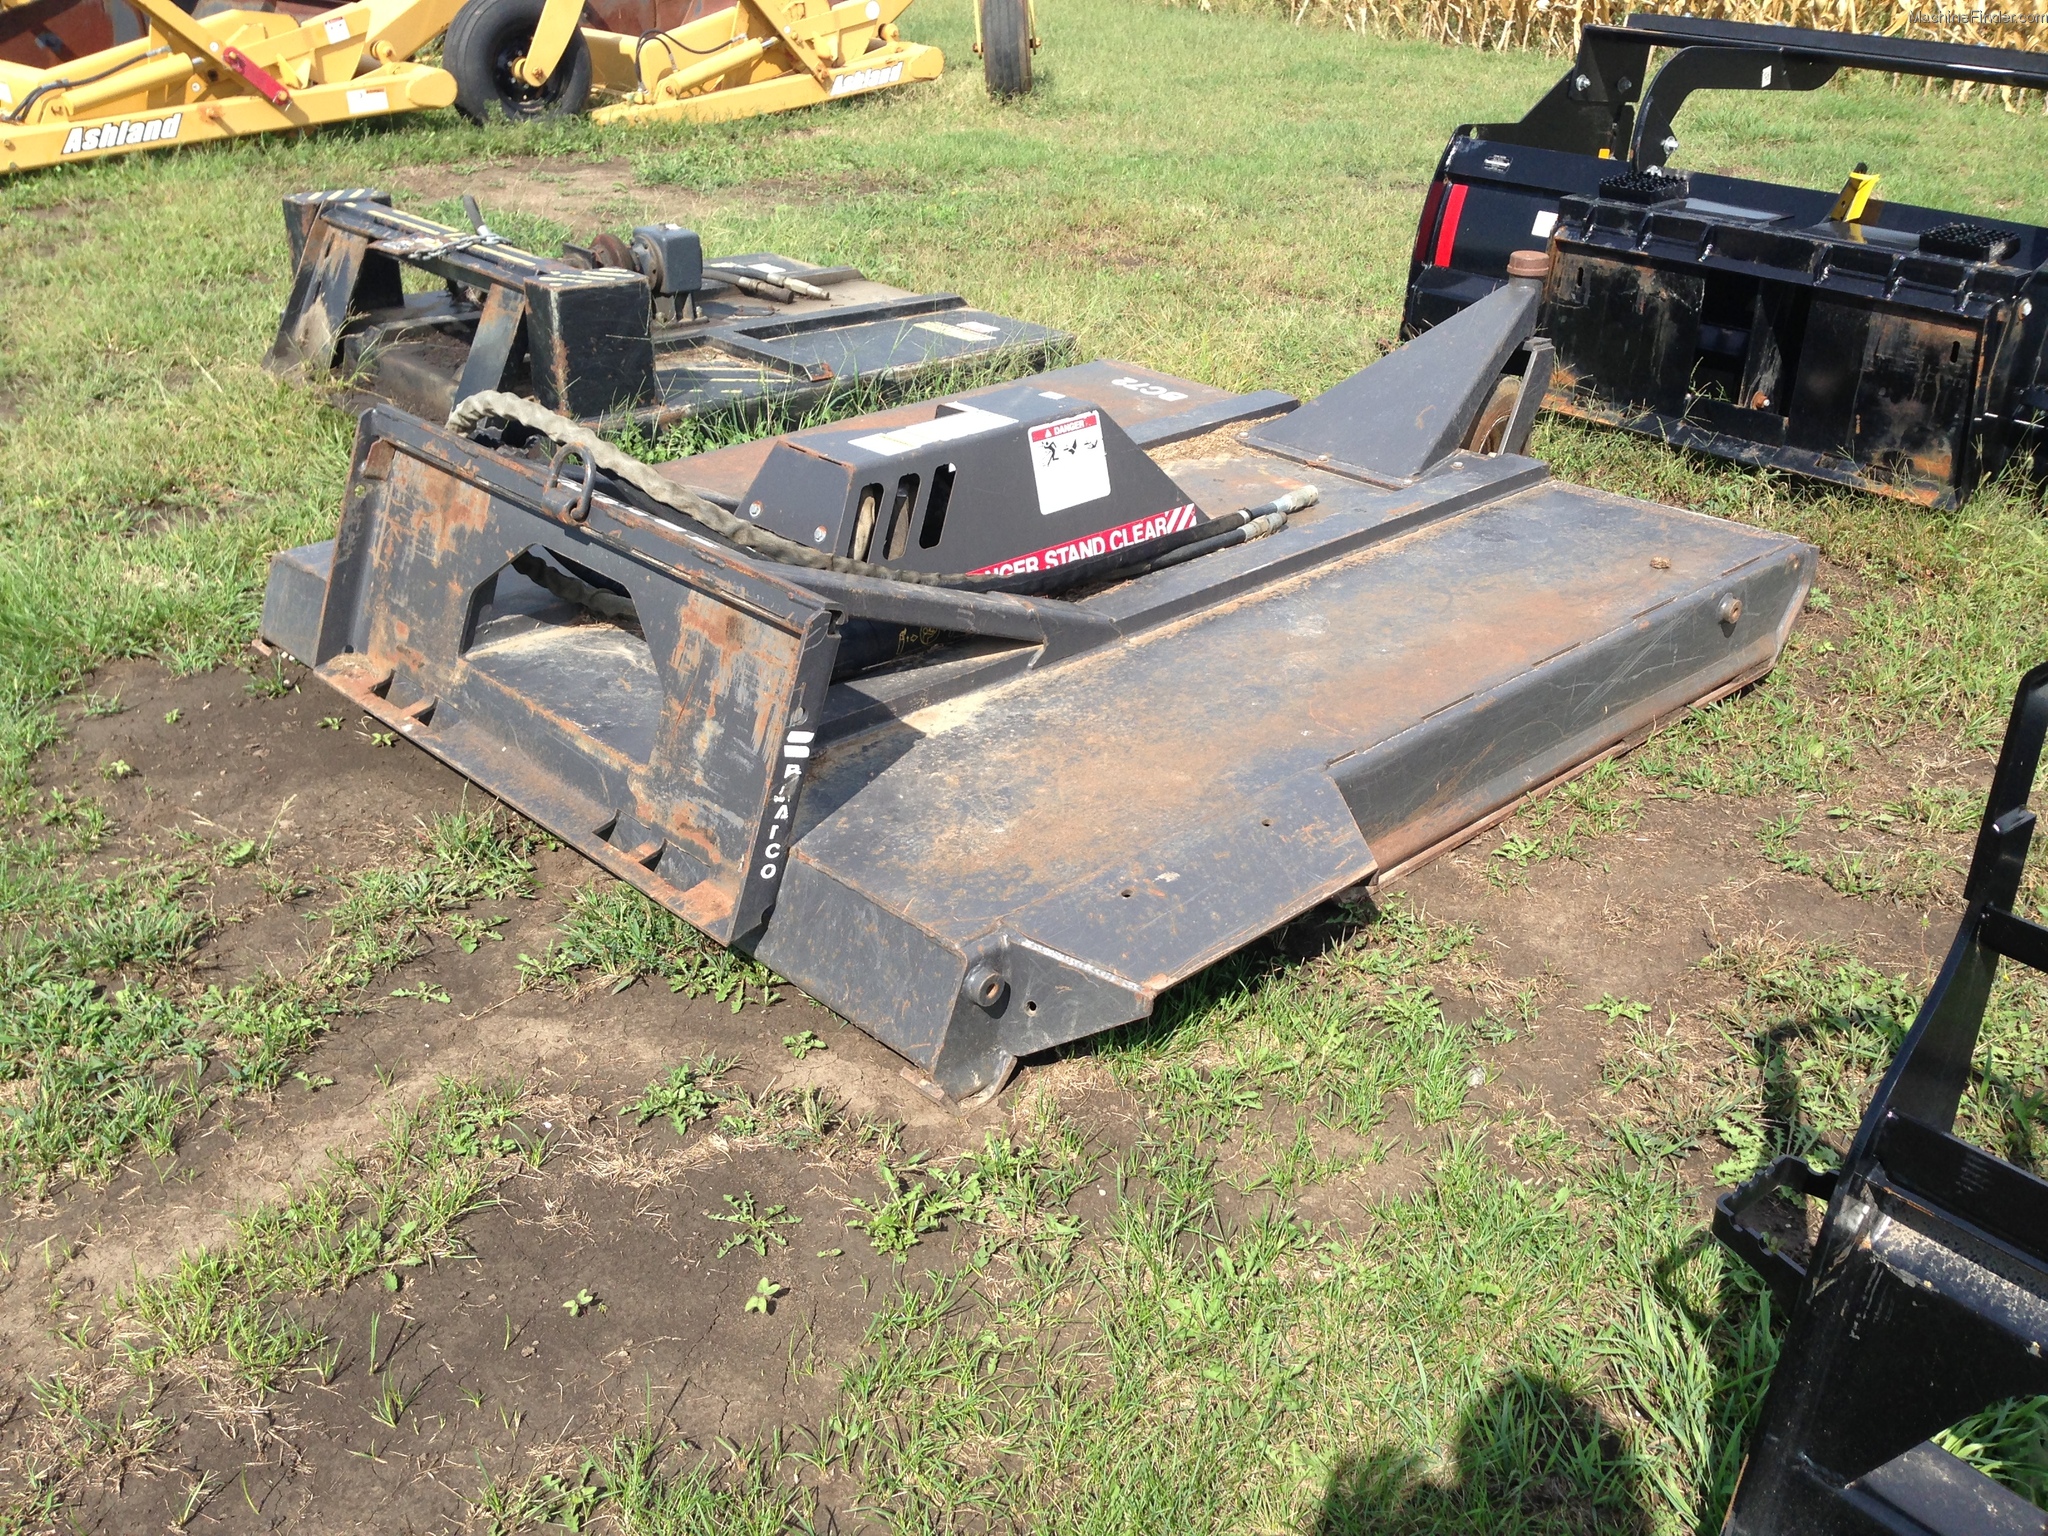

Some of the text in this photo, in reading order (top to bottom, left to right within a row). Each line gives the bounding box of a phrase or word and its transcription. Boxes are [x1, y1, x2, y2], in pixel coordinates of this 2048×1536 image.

[61, 112, 183, 154] Ashland
[1053, 420, 1085, 435] DANGER
[1044, 536, 1105, 570] STAND
[1109, 517, 1166, 550] CLEAR
